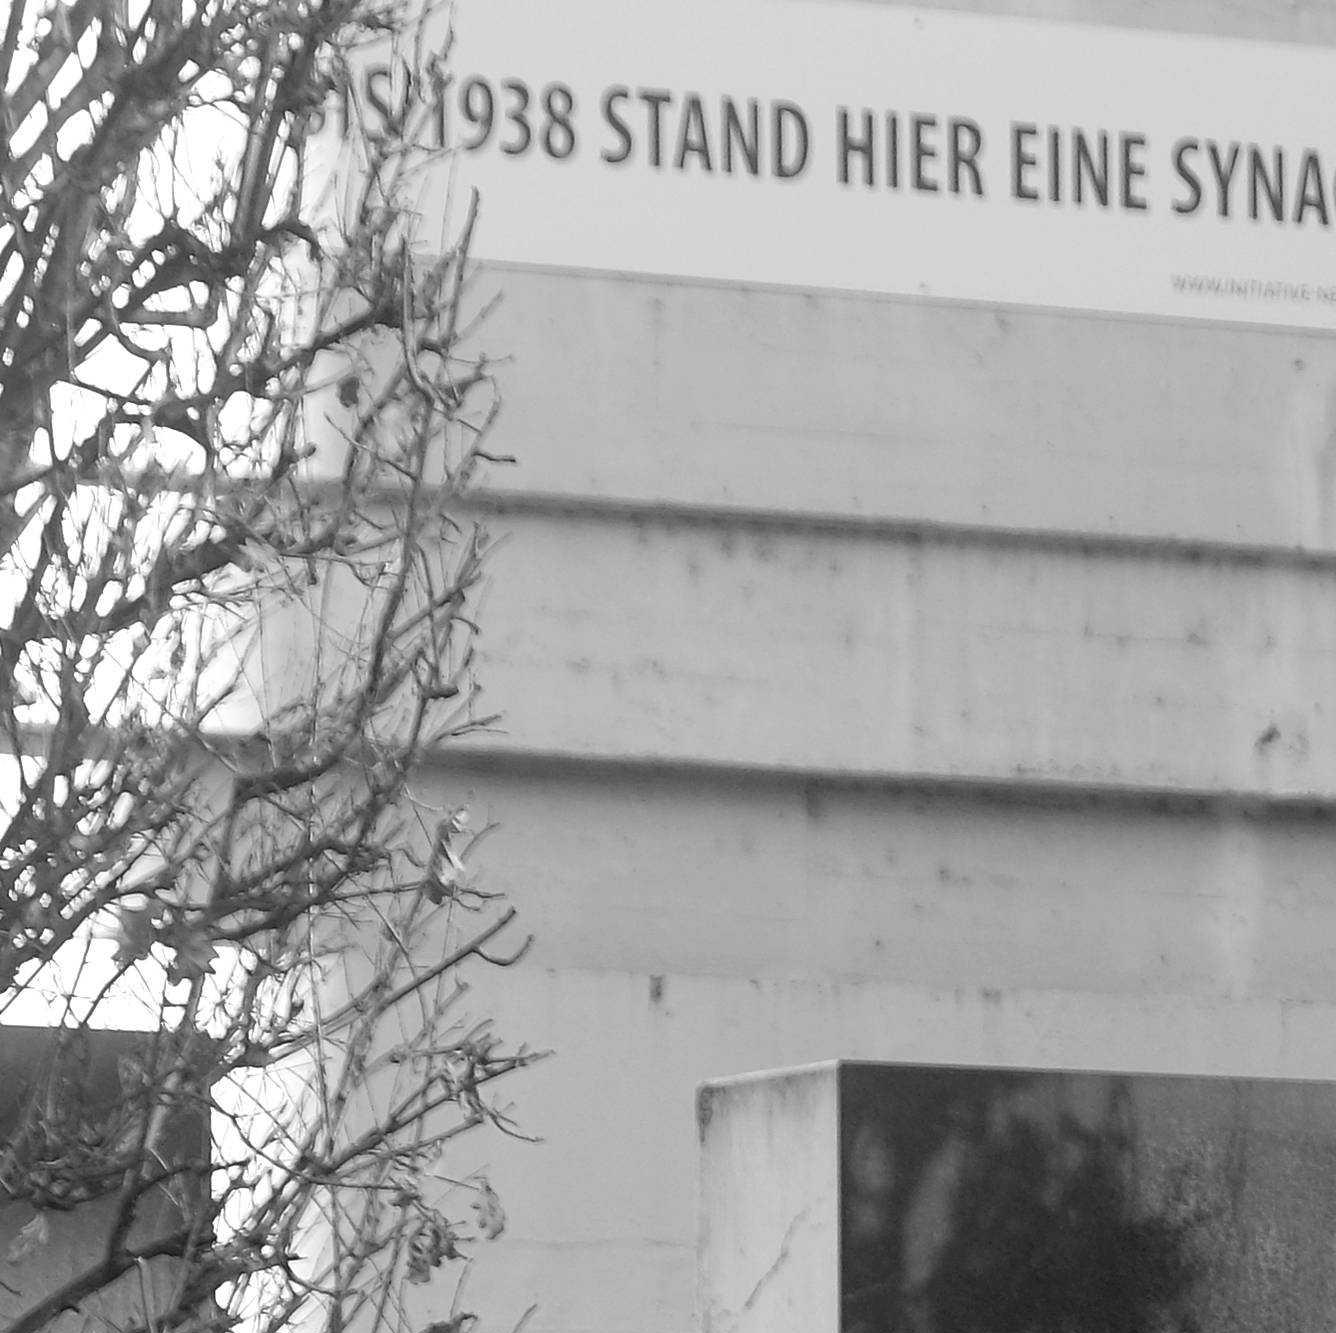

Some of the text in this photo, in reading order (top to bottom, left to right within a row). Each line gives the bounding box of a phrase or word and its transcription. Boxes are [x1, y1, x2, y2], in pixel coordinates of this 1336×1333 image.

[425, 70, 576, 160] 1938
[600, 86, 813, 182] STAND
[835, 104, 987, 198] HIER
[1009, 120, 1148, 212] EINE
